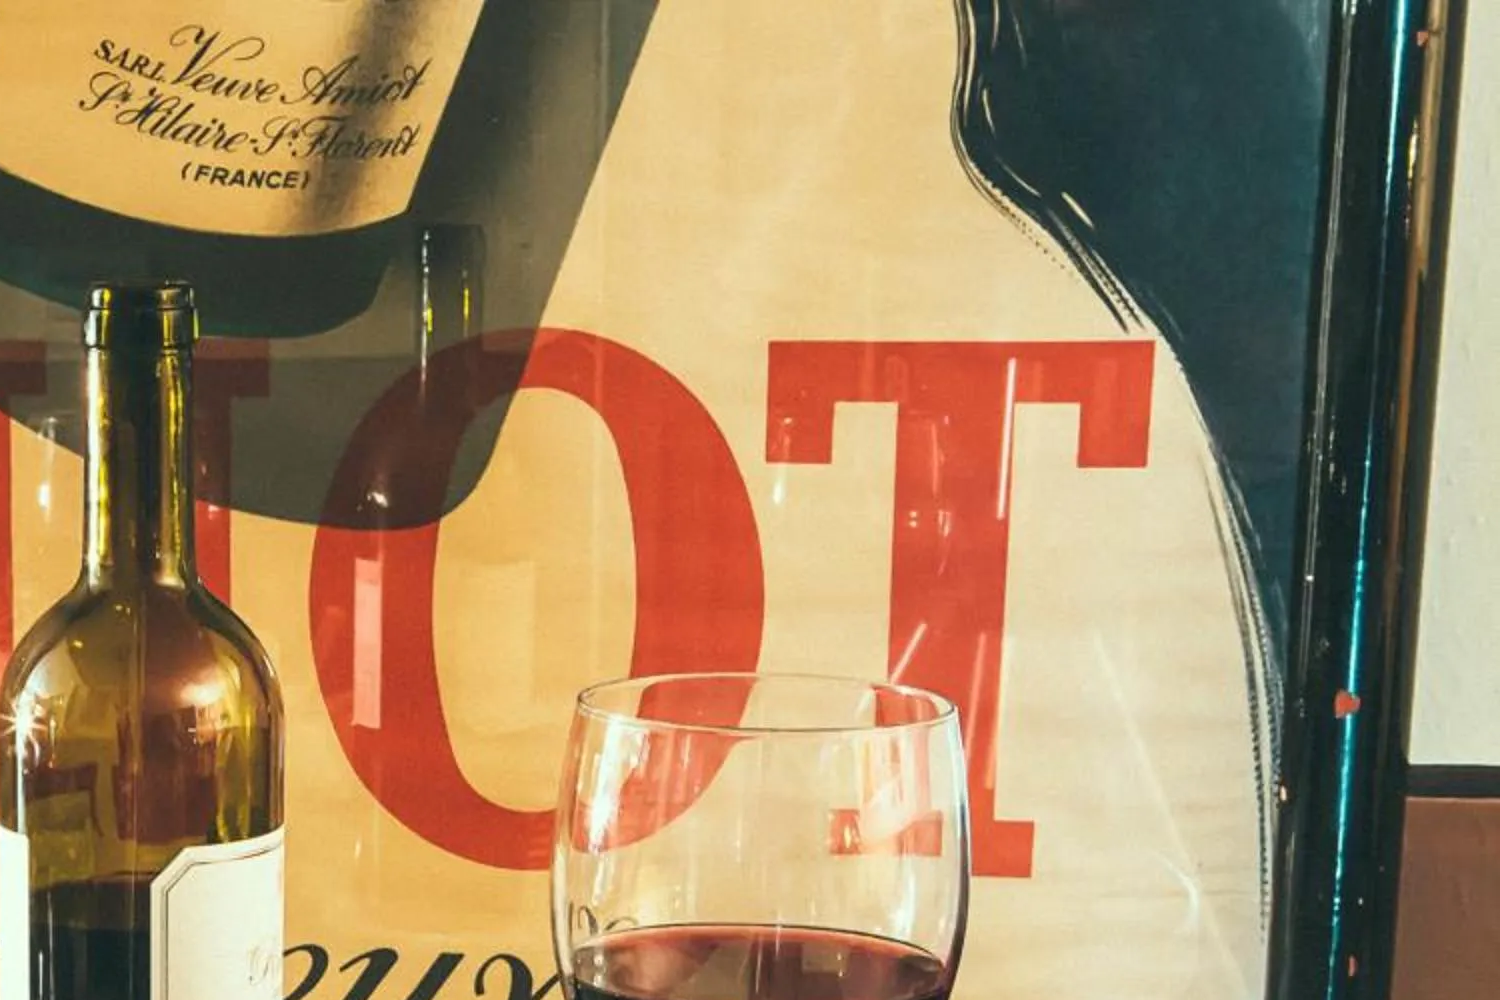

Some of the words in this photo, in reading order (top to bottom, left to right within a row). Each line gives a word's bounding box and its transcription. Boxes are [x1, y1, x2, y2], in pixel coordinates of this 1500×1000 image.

[169, 24, 279, 104] Veuve
[279, 55, 433, 105] Amiot
[293, 114, 421, 159] Florent
[181, 161, 310, 191] (FRANCE)
